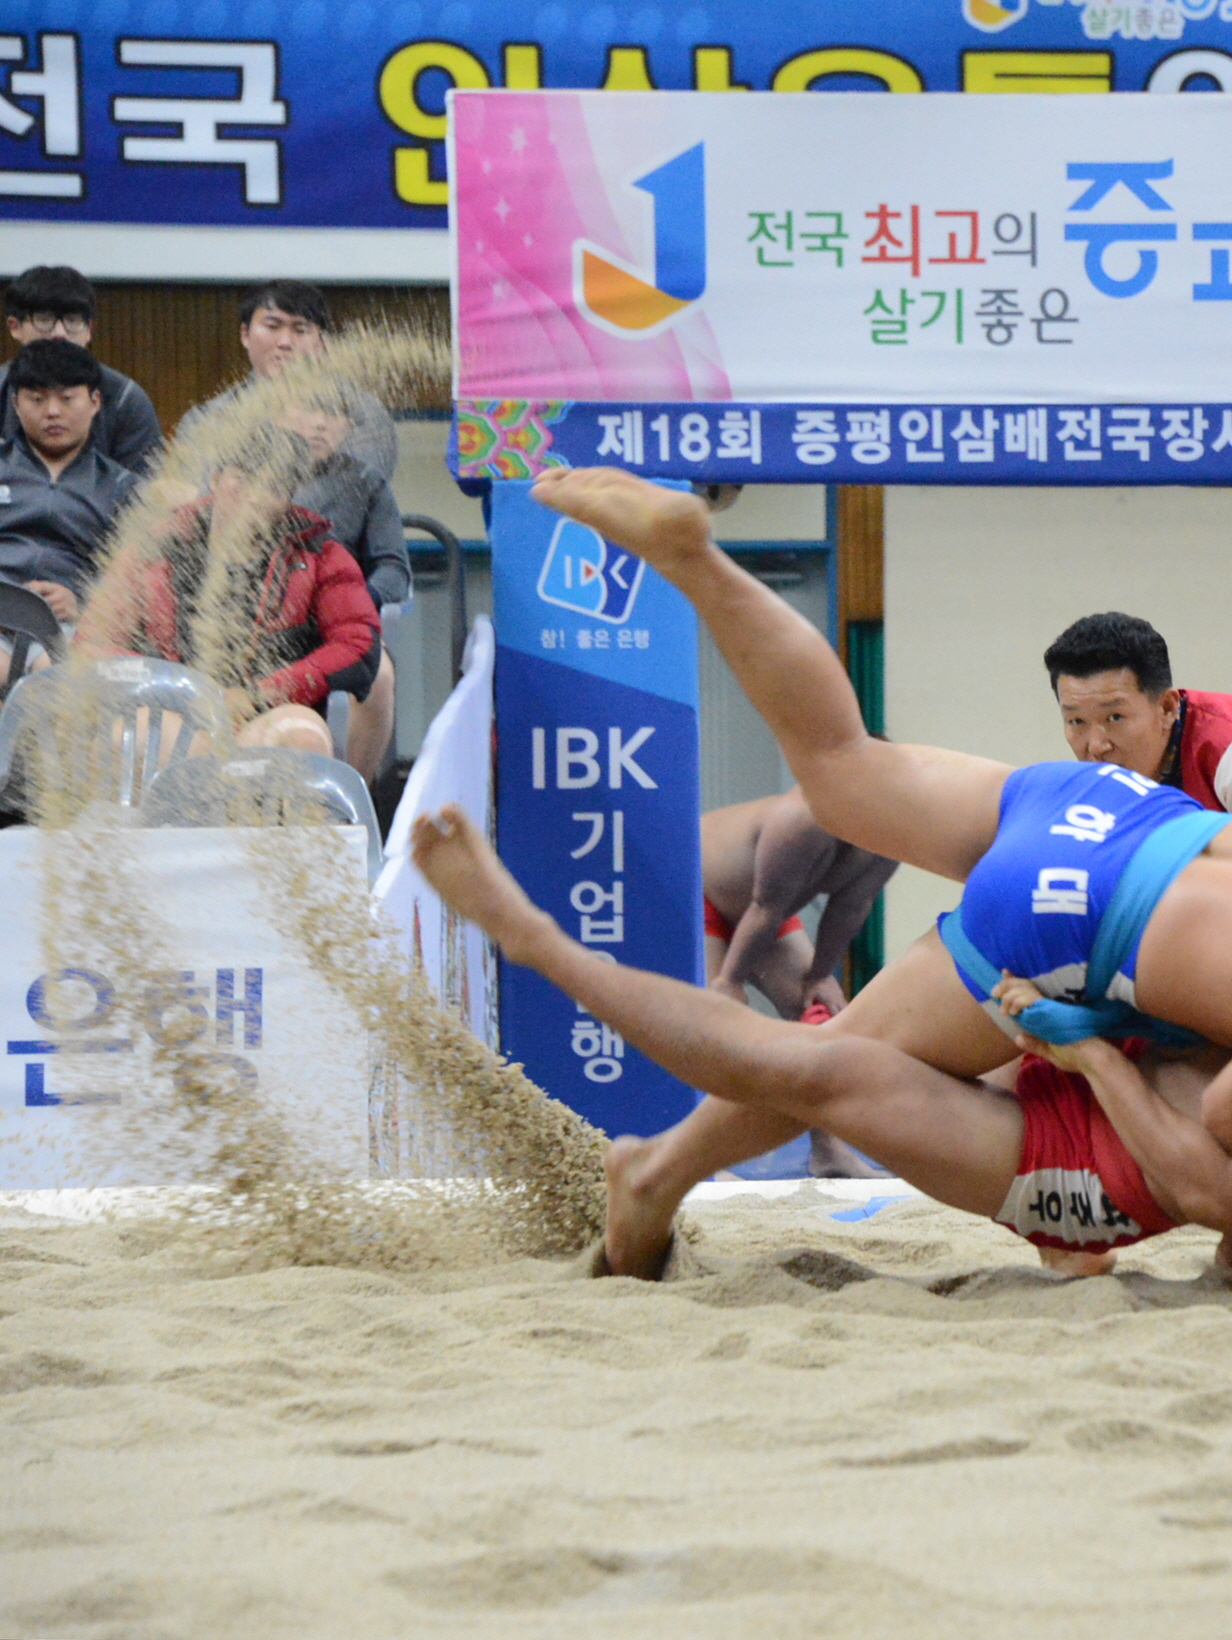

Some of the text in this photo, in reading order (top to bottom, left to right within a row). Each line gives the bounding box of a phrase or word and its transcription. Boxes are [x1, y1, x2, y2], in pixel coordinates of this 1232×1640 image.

[747, 211, 849, 268] 전국
[861, 204, 1038, 277] 최고의
[863, 288, 1080, 346] 살기좋은
[596, 409, 762, 465] 제18회
[576, 628, 612, 650] 좋은
[617, 628, 651, 650] 은행
[531, 726, 660, 790] IBK
[569, 810, 625, 1084] 기업행
